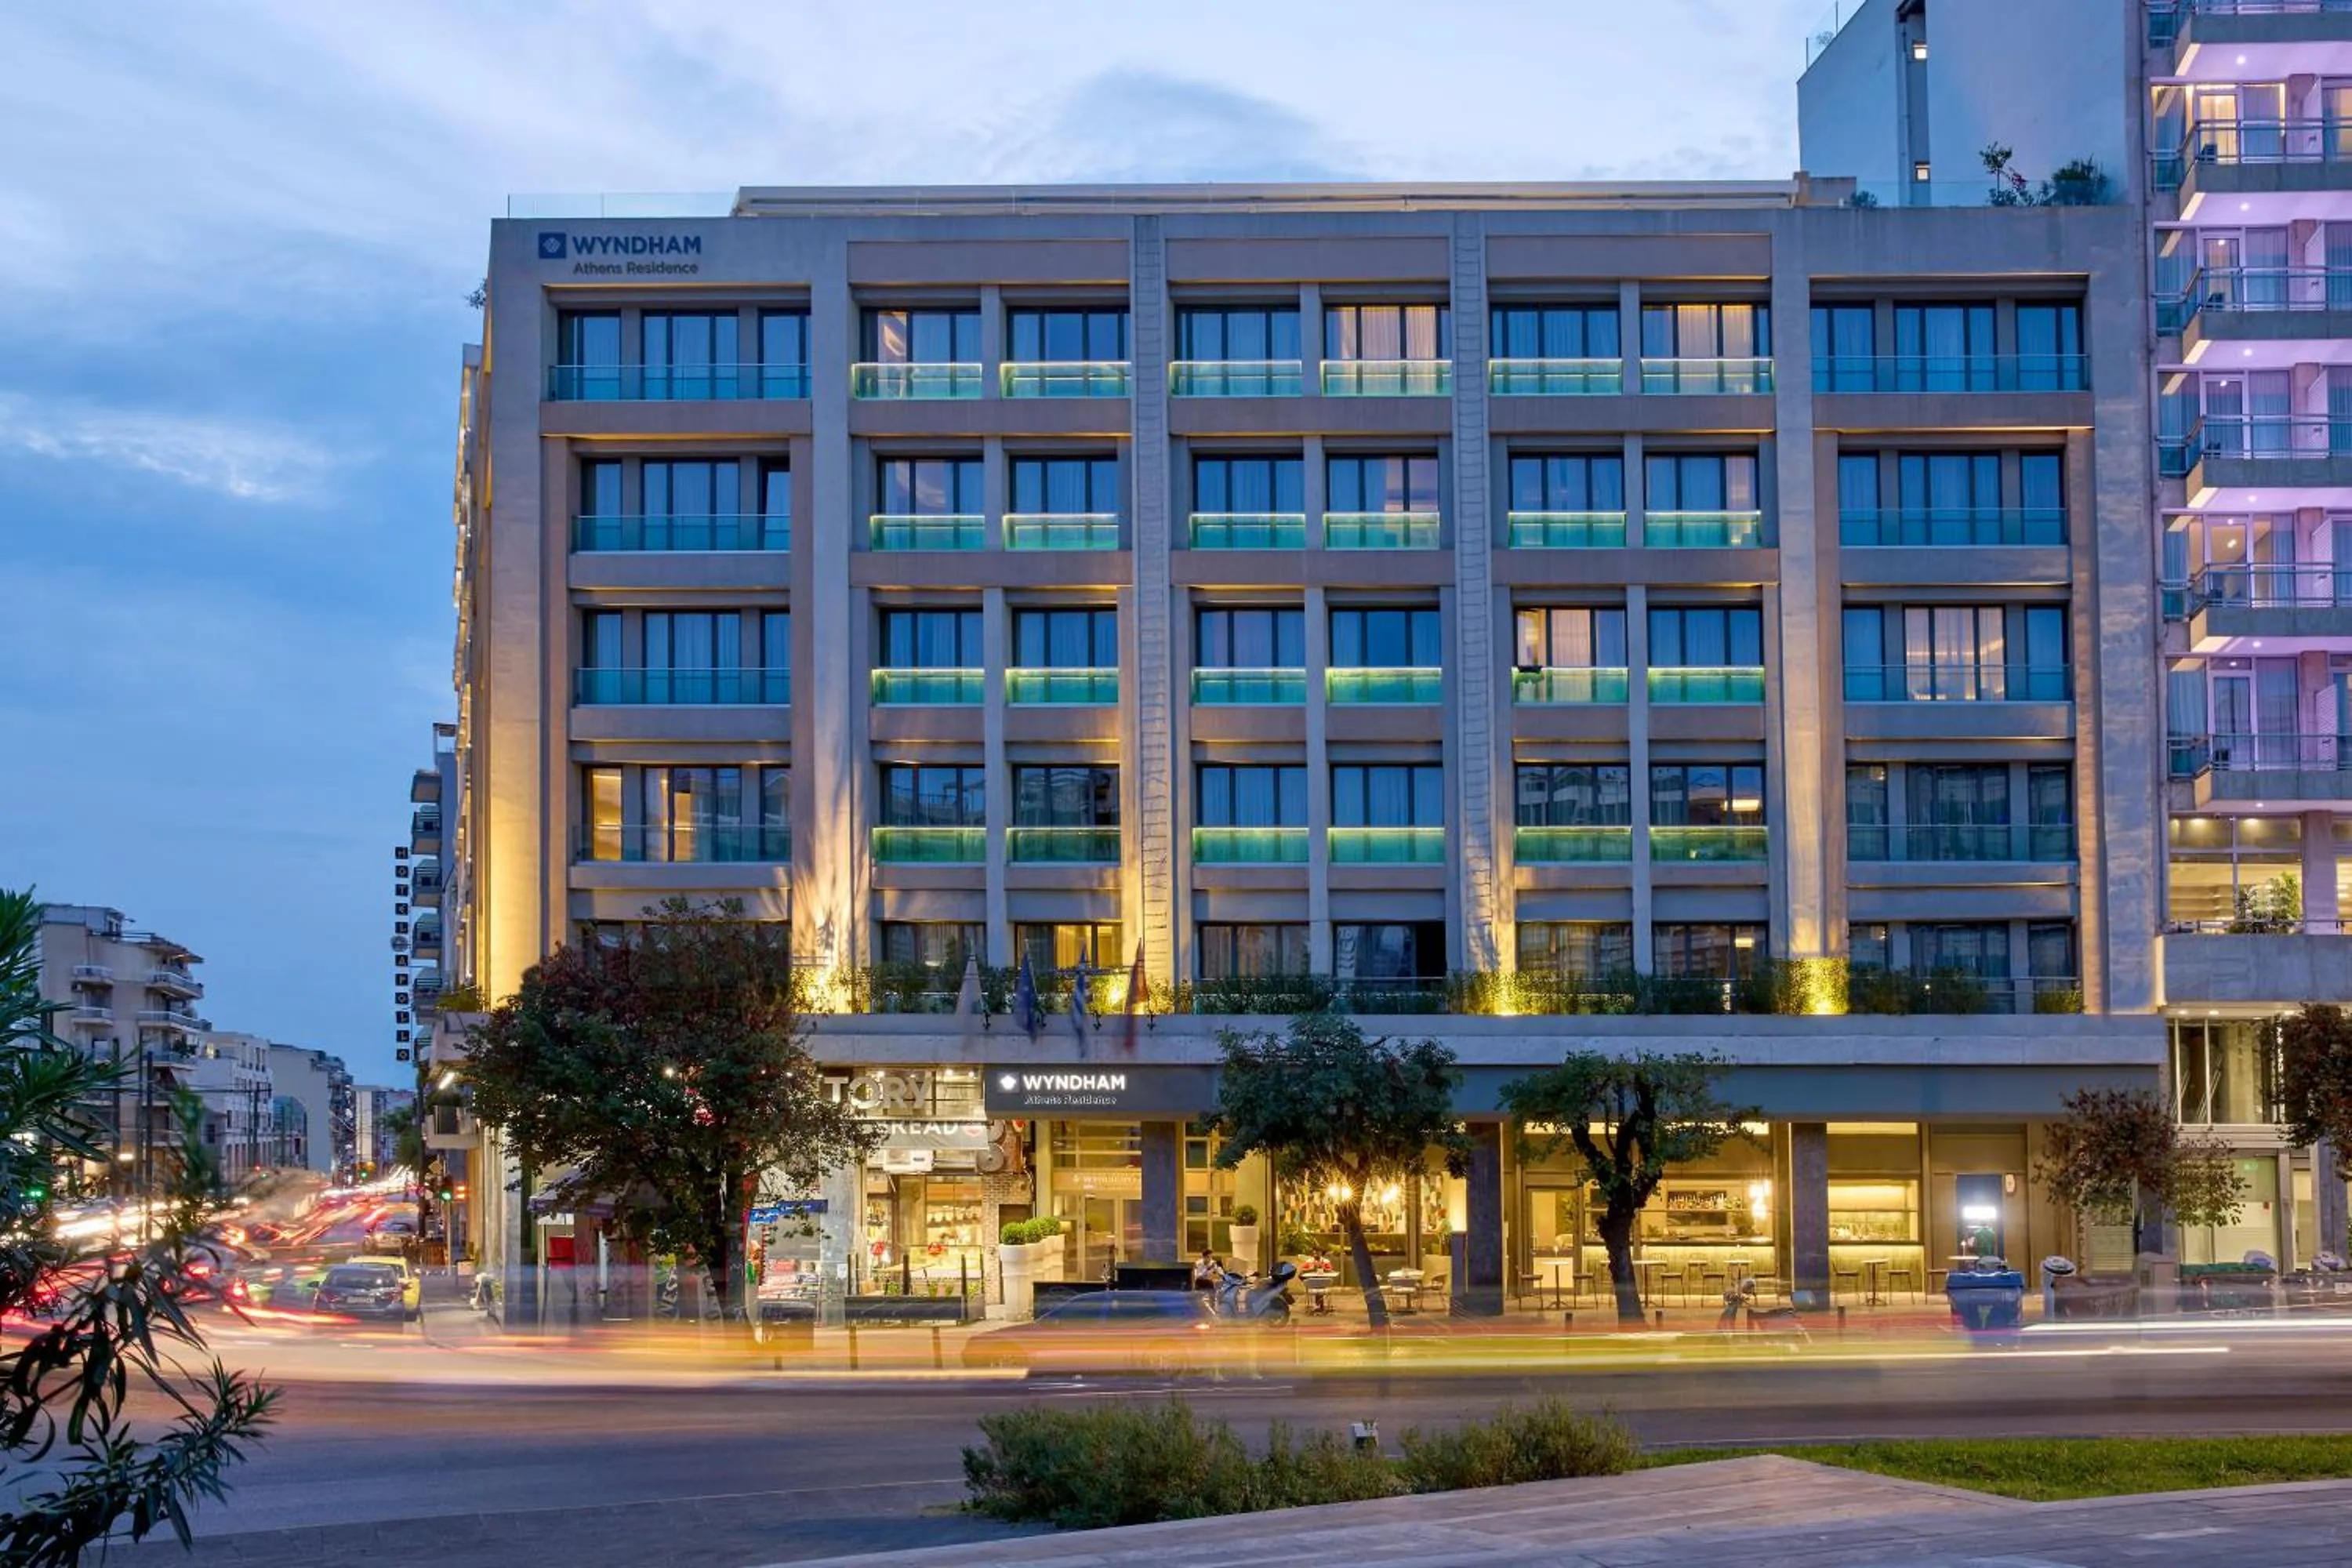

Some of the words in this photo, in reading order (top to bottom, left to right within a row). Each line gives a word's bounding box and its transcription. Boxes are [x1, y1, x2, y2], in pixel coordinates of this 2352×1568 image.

[572, 236, 702, 255] WYNDHAM
[573, 262, 622, 274] Athens
[626, 262, 699, 274] Residence
[396, 955, 408, 1060] APOLLO
[1022, 1075, 1126, 1091] WYNDHAM
